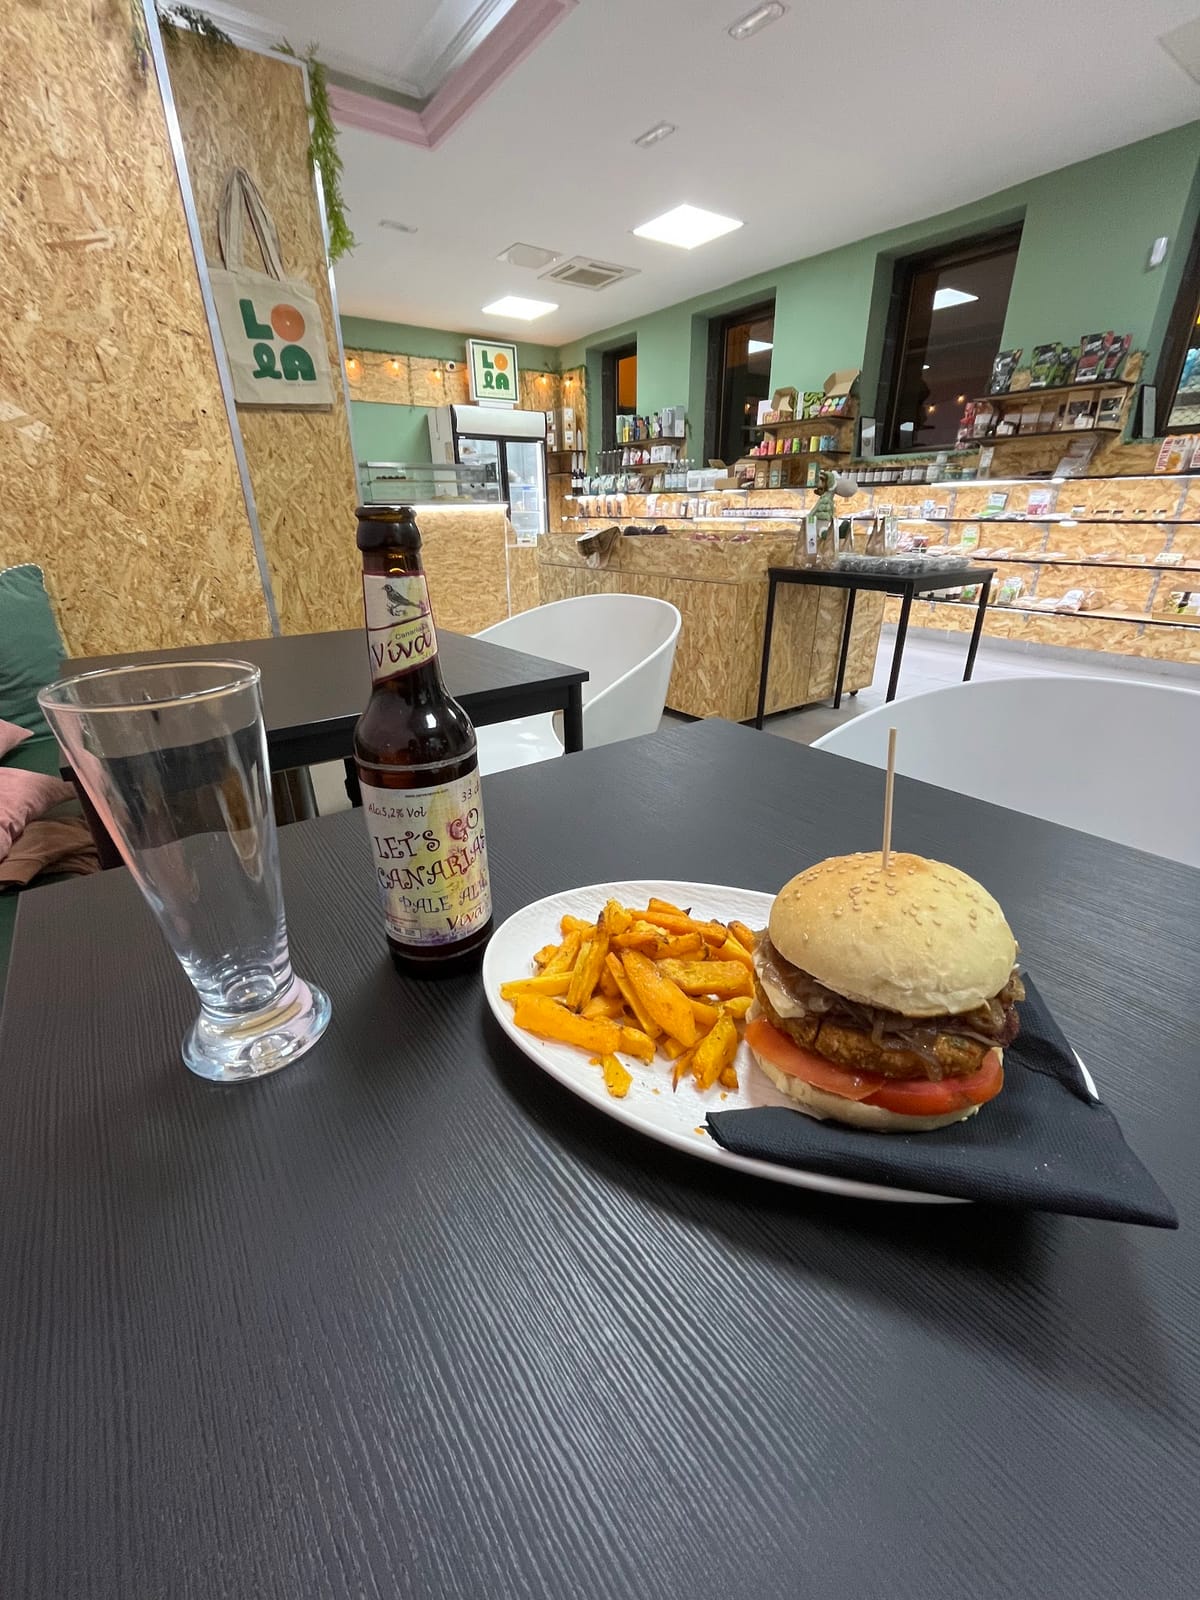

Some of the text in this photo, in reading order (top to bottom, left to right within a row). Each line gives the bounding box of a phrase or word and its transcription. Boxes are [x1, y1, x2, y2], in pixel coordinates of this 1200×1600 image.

[461, 788, 472, 803] 33
[406, 806, 427, 818] Vol
[449, 807, 479, 842] GO
[399, 895, 453, 914] PALE
